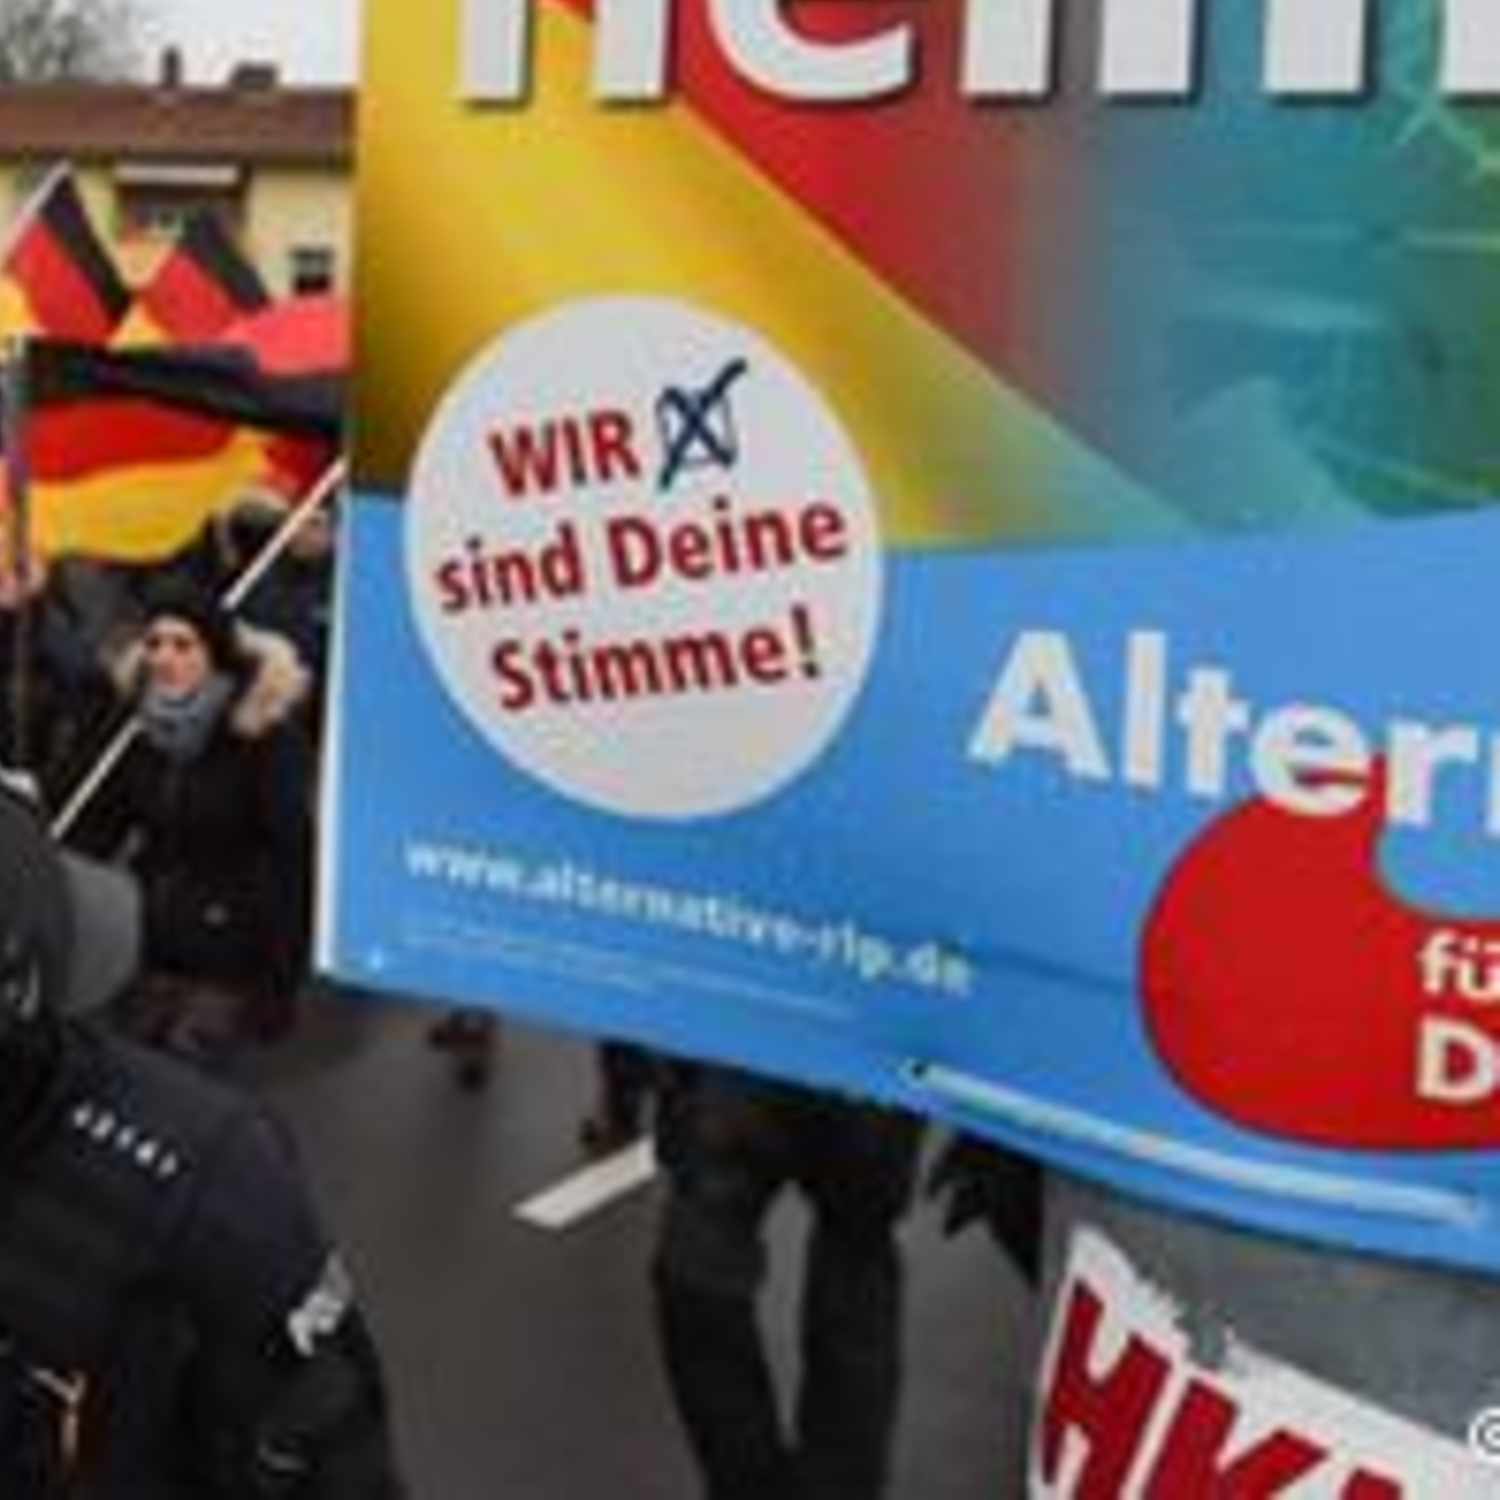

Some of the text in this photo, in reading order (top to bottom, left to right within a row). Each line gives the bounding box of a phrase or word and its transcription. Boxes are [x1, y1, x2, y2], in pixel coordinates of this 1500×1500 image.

[487, 408, 640, 498] WIR
[436, 498, 848, 614] sind Deine
[493, 604, 818, 712] Stimme!
[968, 630, 1500, 837] Alter
[407, 840, 972, 997] www.alternative-rlp.de
